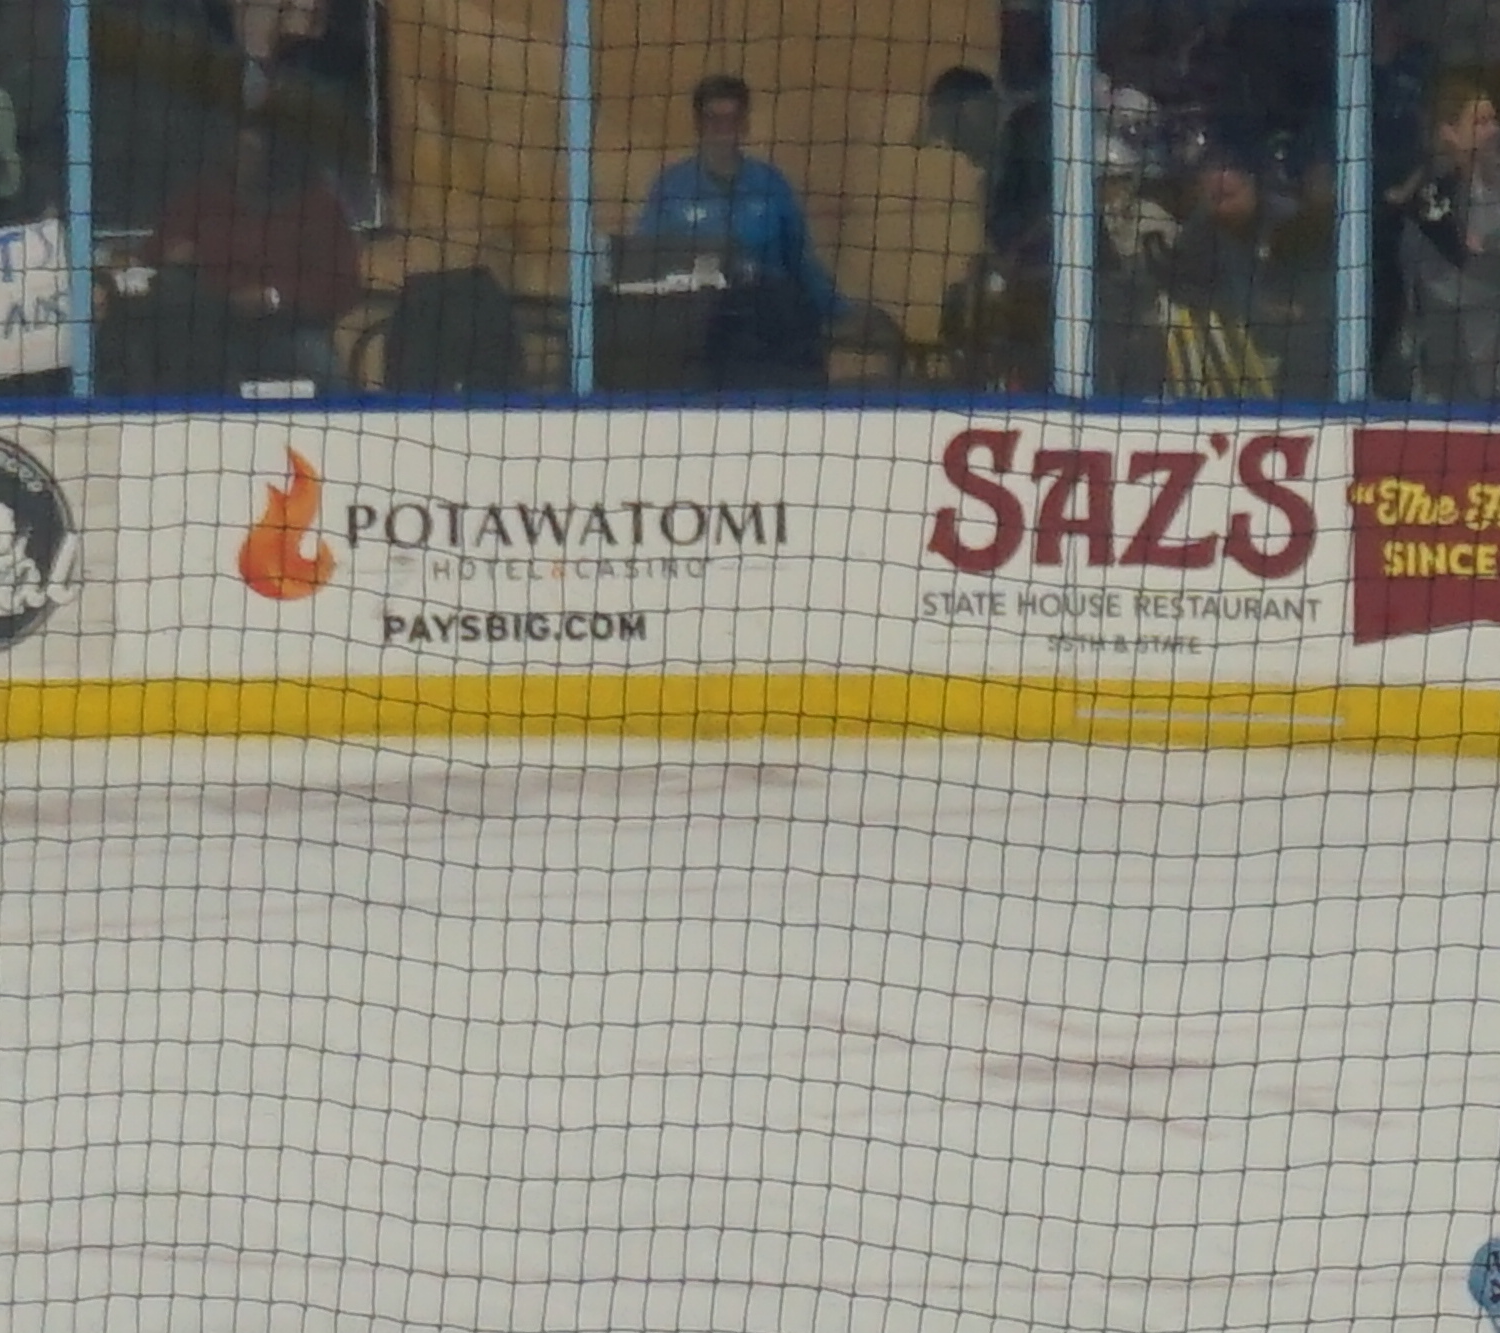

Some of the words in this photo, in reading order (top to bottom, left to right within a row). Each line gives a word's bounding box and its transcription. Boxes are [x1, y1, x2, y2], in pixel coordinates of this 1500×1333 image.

[928, 429, 1317, 578] SAZ'S
[348, 502, 787, 548] POTAWATOMI
[1384, 541, 1498, 580] SINCE
[923, 592, 1007, 617] STATE
[1018, 593, 1122, 618] HOUSE
[1134, 595, 1322, 622] RESTAURANT
[383, 614, 646, 642] PAYSBIG.COM
